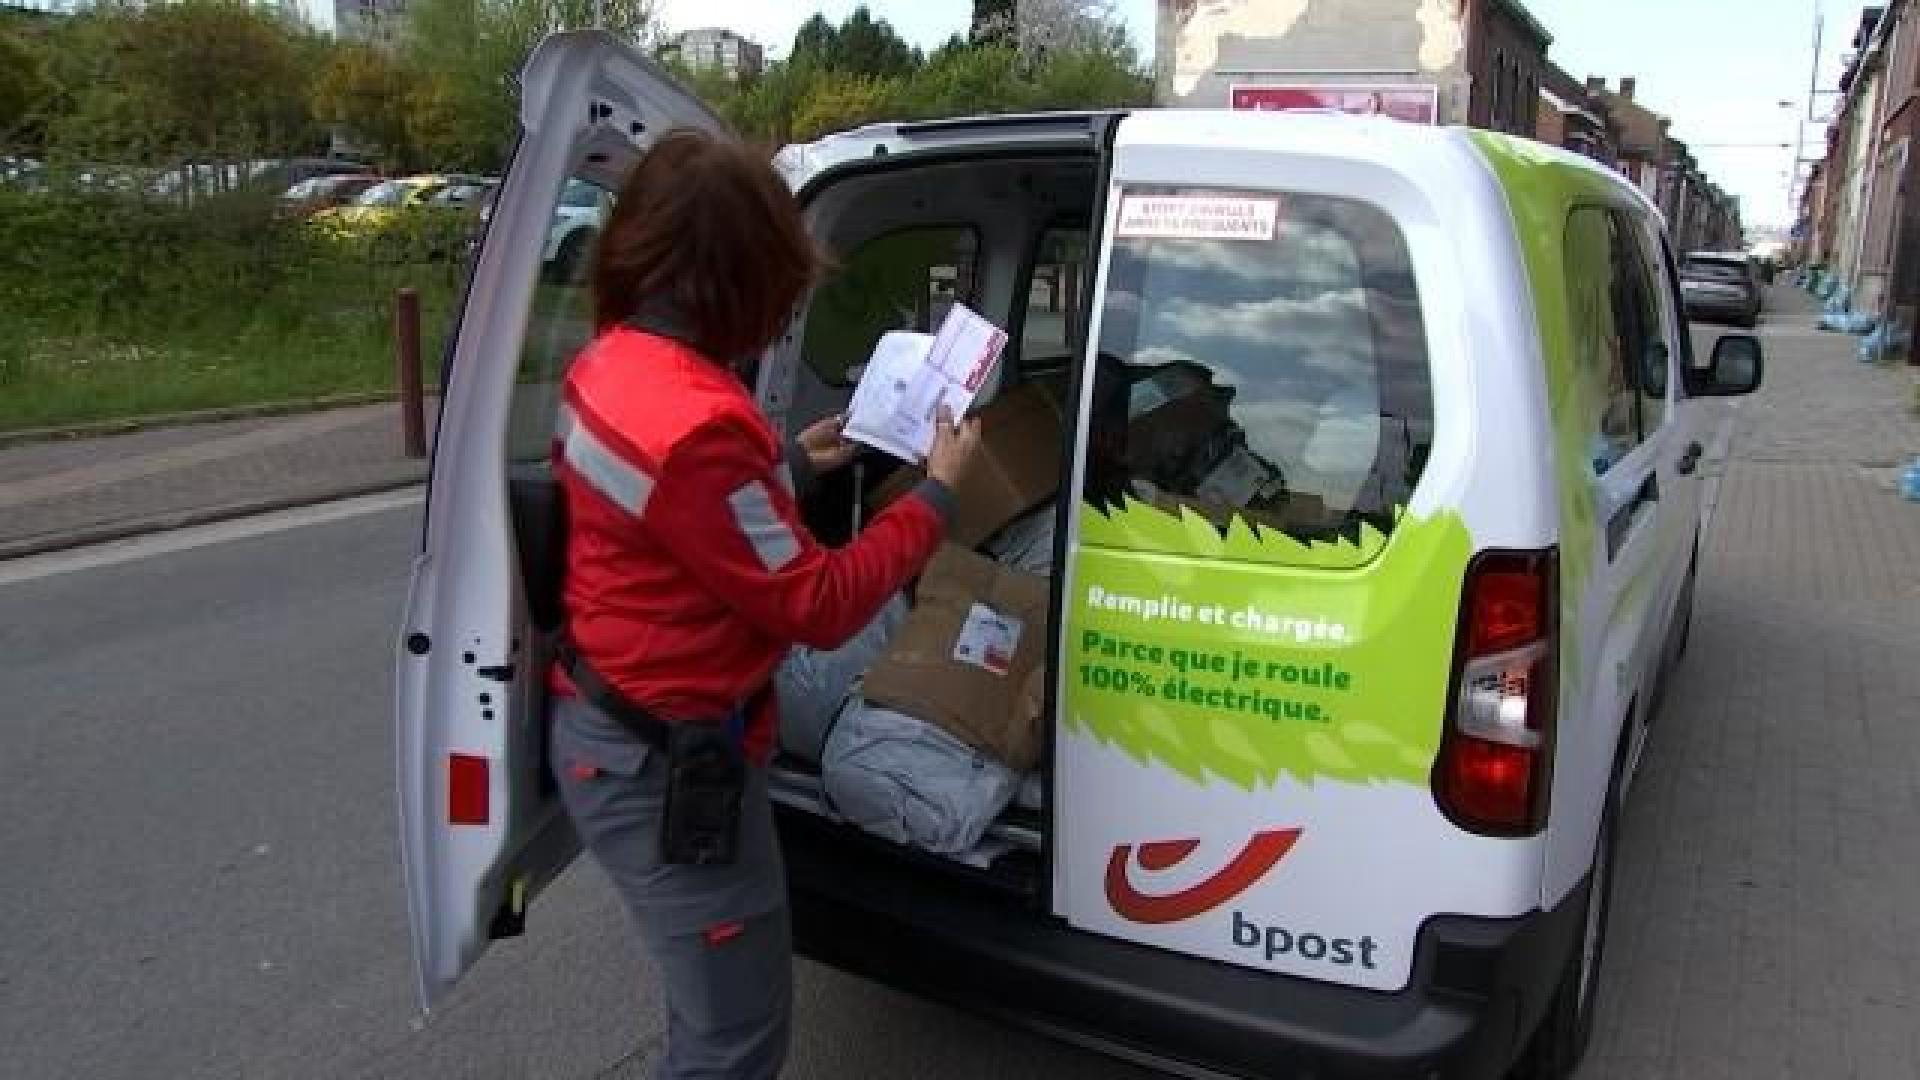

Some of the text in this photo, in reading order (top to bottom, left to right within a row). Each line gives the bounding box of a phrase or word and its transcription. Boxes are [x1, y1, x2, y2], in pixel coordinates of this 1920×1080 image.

[1087, 584, 1192, 621] Remplie
[1199, 605, 1225, 625] et
[1082, 630, 1352, 690] Parce que je roule
[1079, 664, 1330, 722] 100% électrique.
[1232, 911, 1378, 969] bpost
